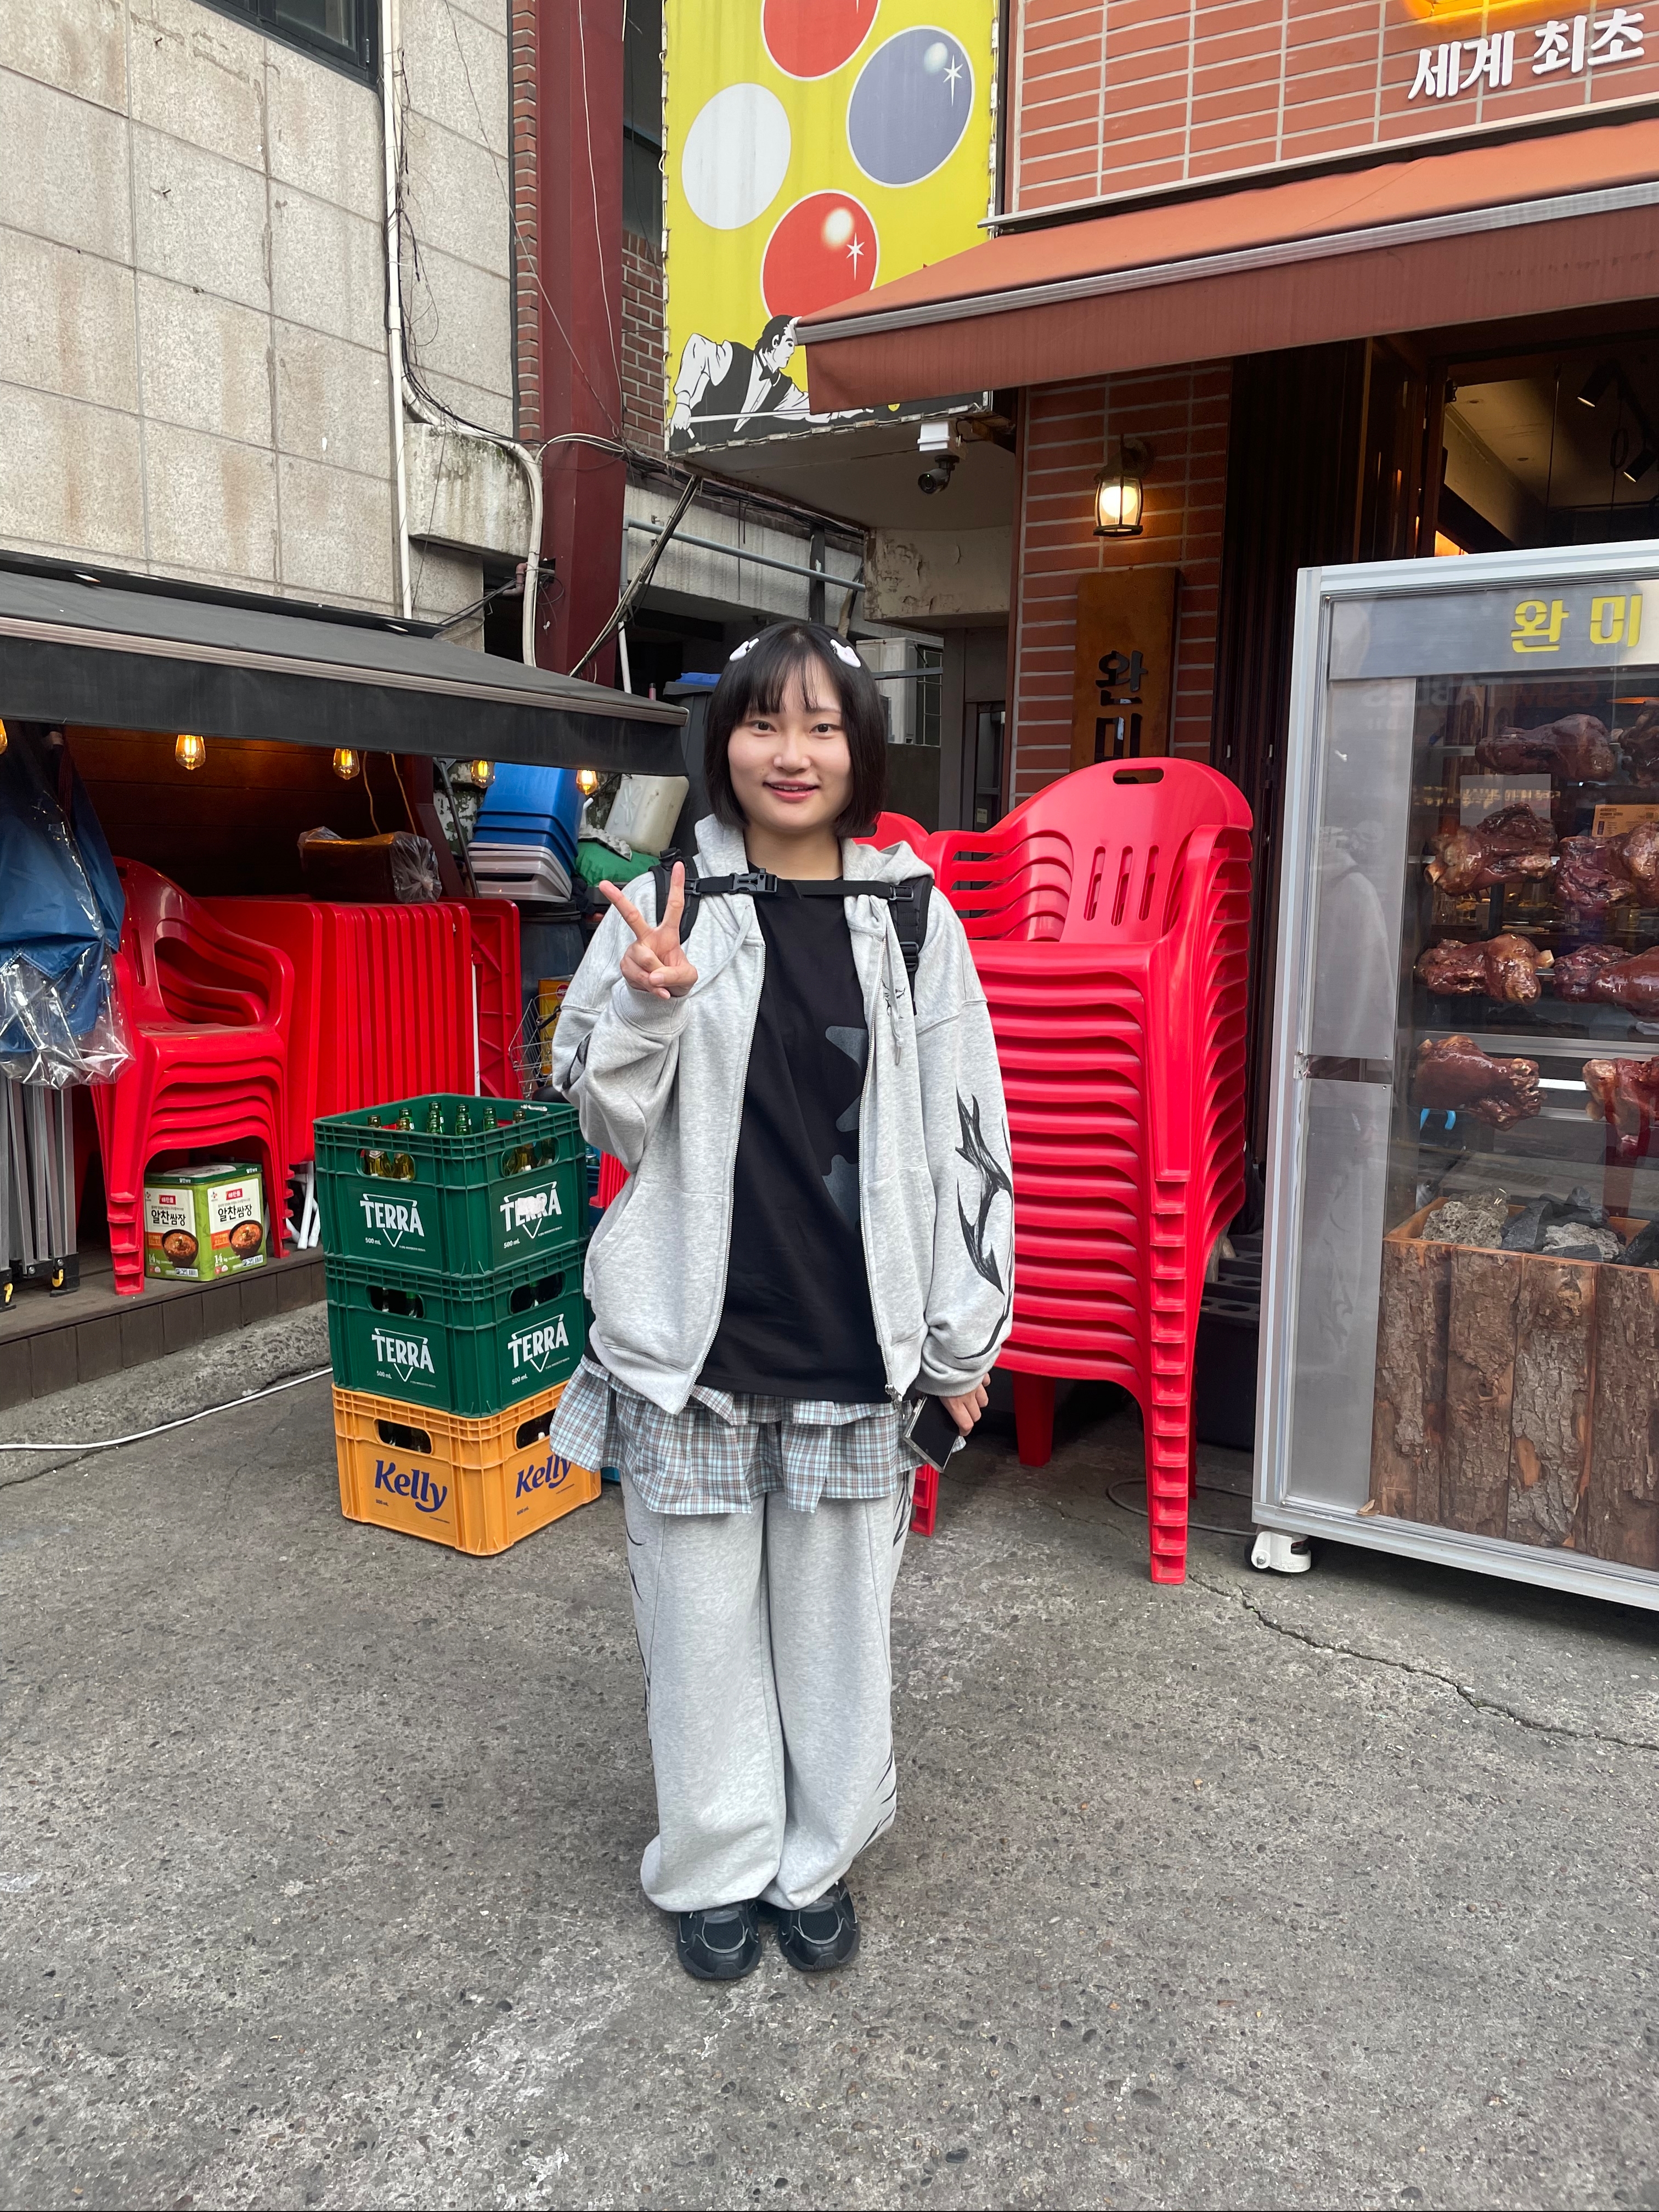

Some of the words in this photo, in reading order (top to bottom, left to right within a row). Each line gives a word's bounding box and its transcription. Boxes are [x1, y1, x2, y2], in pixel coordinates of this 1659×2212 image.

[1408, 30, 1515, 100] 세계
[1532, 8, 1645, 75] 최초
[1510, 594, 1643, 653] 완미
[1094, 650, 1148, 784] 완미
[151, 1210, 186, 1226] 알찬쌈장
[218, 1204, 252, 1222] 알찬쌈장
[360, 1200, 425, 1237] TERRA
[149, 1253, 155, 1263] 14
[215, 1252, 223, 1263] 14
[504, 1240, 513, 1249] 500
[371, 1334, 435, 1374] TERRA
[507, 1321, 569, 1368] TERRA
[512, 1376, 521, 1385] 500
[375, 1459, 448, 1513] Kelly
[516, 1454, 572, 1498] Kelly
